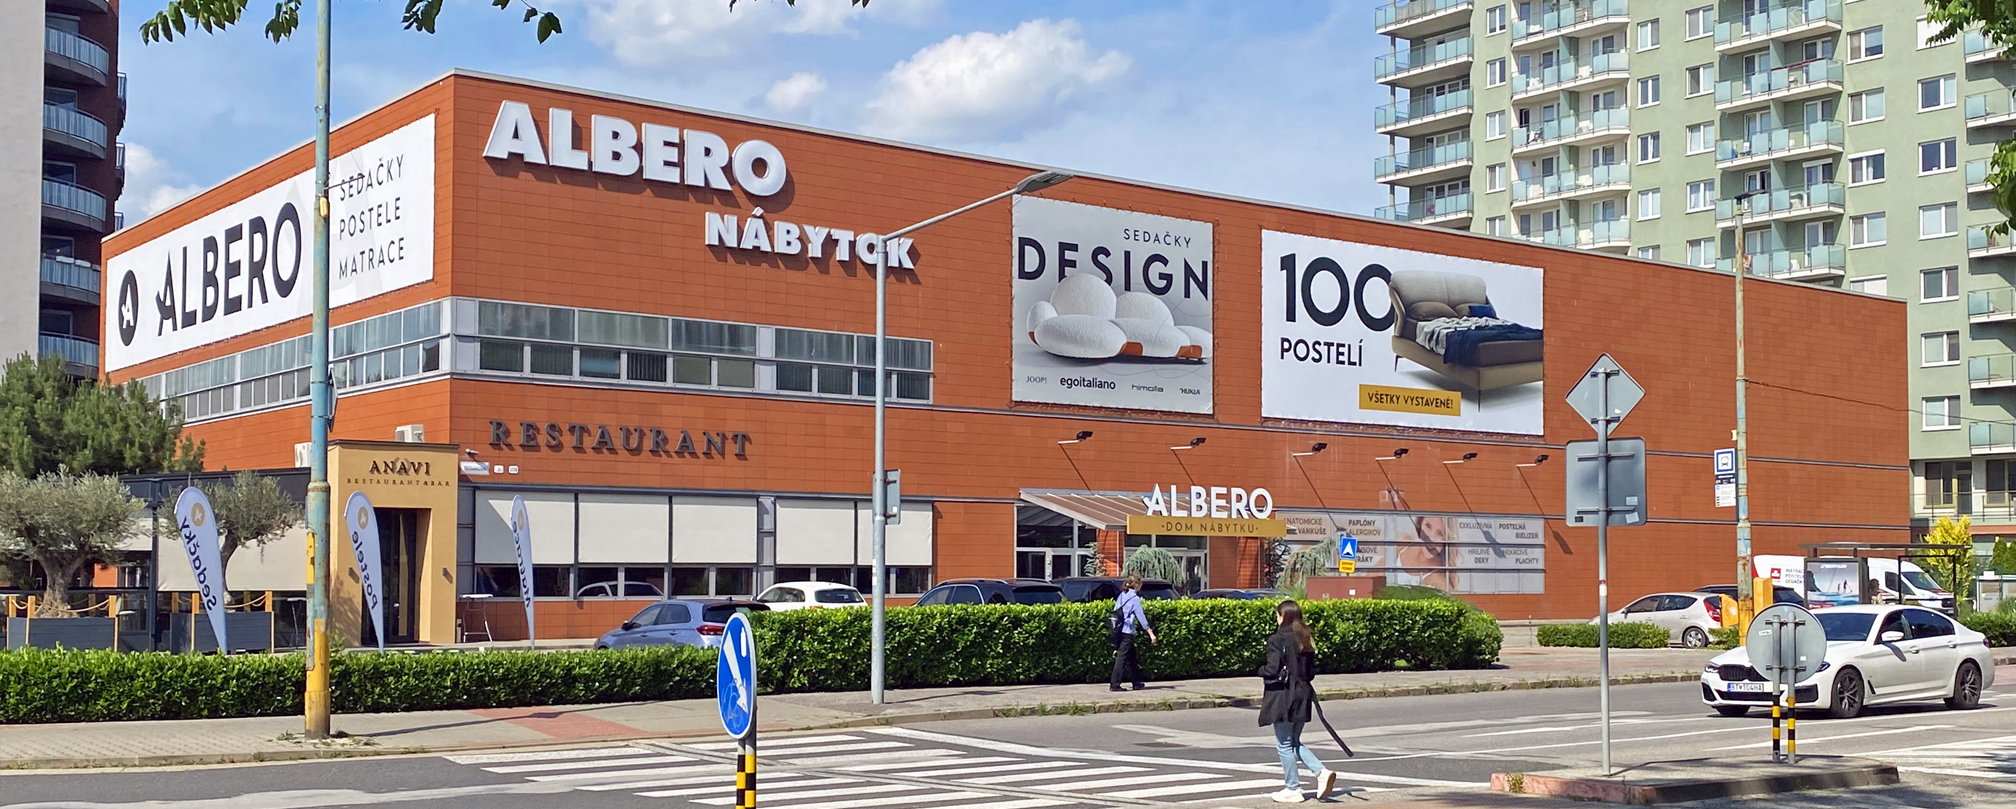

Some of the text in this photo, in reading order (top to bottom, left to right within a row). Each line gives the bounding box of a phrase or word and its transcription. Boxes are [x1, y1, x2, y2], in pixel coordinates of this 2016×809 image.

[482, 100, 787, 197] ALBERO
[340, 154, 403, 201] SEDAČKY
[340, 197, 401, 241] POSTELE
[705, 206, 915, 269] NÁBYTOK
[1123, 228, 1191, 248] SEDAČKY
[155, 202, 302, 337] ALBERO
[339, 237, 404, 280] MATRACE
[1017, 236, 1209, 301] DESIGN
[1280, 253, 1394, 332] 100
[1280, 338, 1364, 367] POSTELÍ
[1059, 376, 1116, 390] egoitaliano
[1367, 391, 1454, 409] VŠETKY VYSTAVENÉ!
[488, 420, 751, 459] RESTAURANT
[369, 460, 431, 476] ANAVI
[1142, 483, 1273, 519] ALBERO
[1166, 520, 1254, 533] DOM NÁBYTKU
[1284, 517, 1323, 525] NATOMICKÉ
